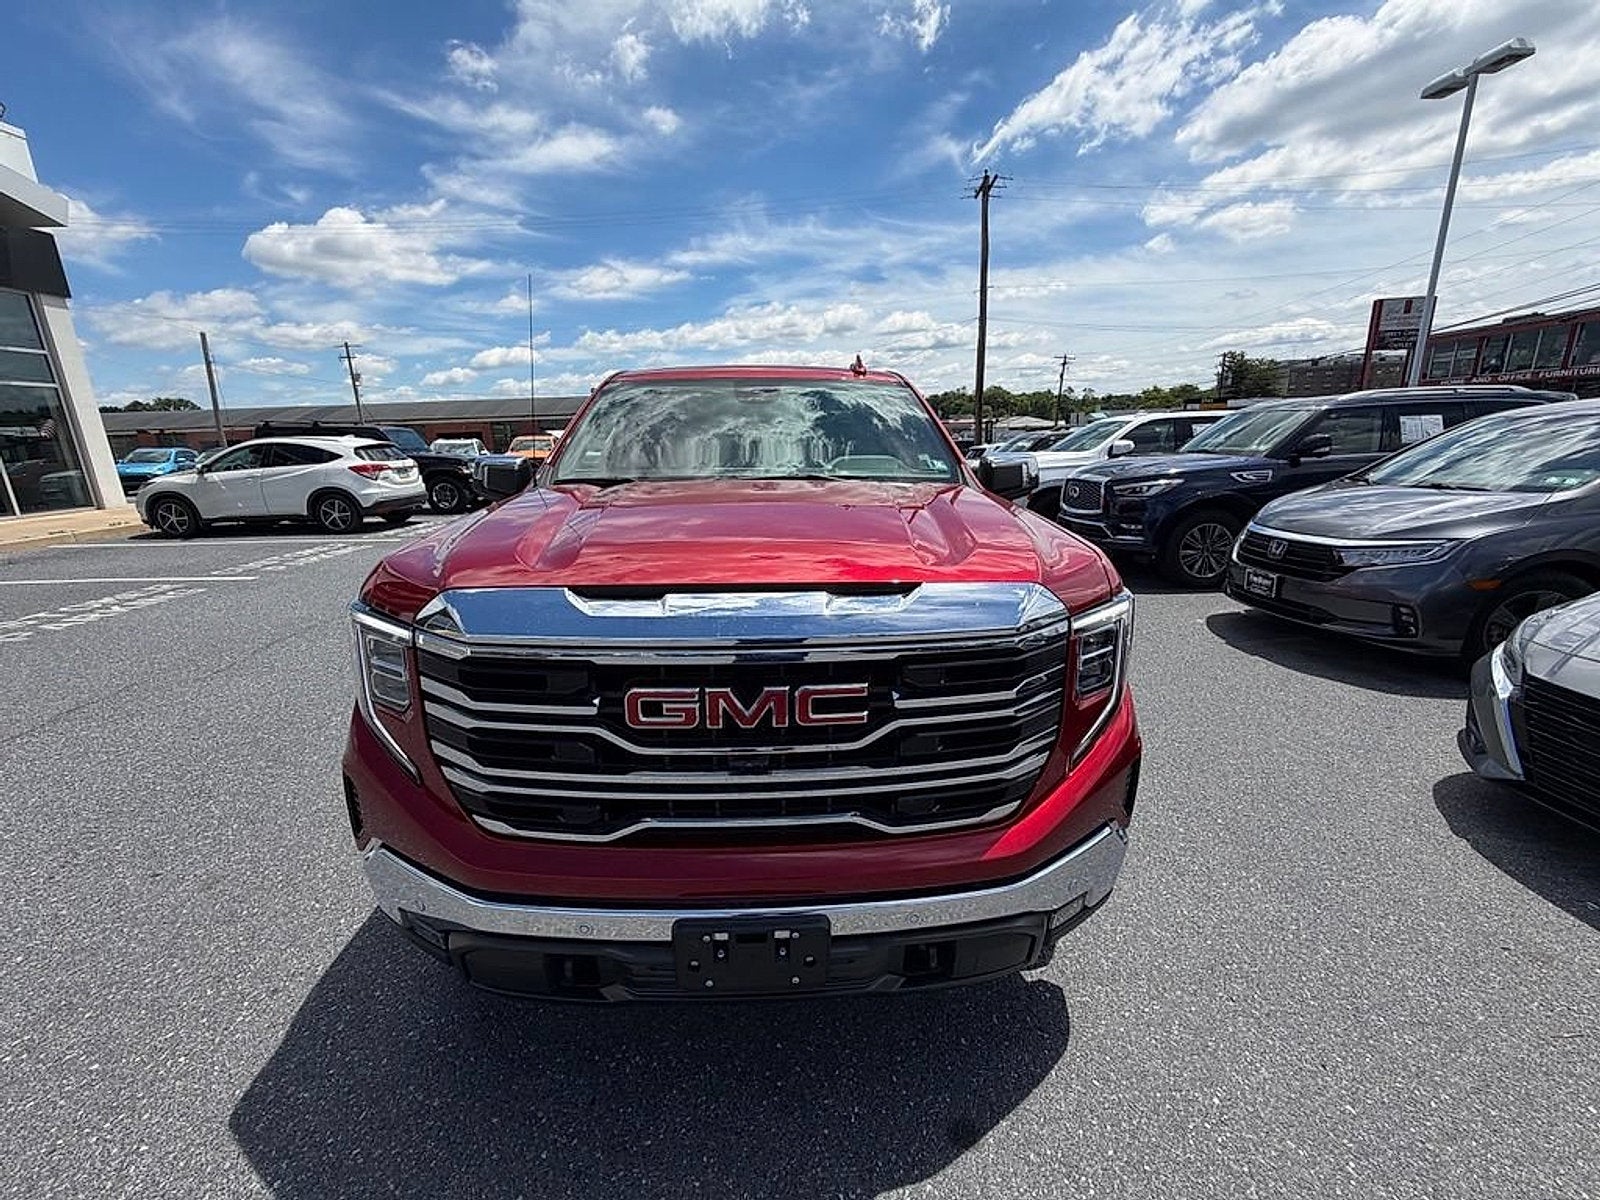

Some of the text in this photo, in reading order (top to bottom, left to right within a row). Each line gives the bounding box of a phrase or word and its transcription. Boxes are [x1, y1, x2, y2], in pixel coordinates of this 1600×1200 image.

[1471, 375, 1492, 383] AND
[1497, 372, 1532, 381] OFFICE
[624, 682, 869, 729] GMC
